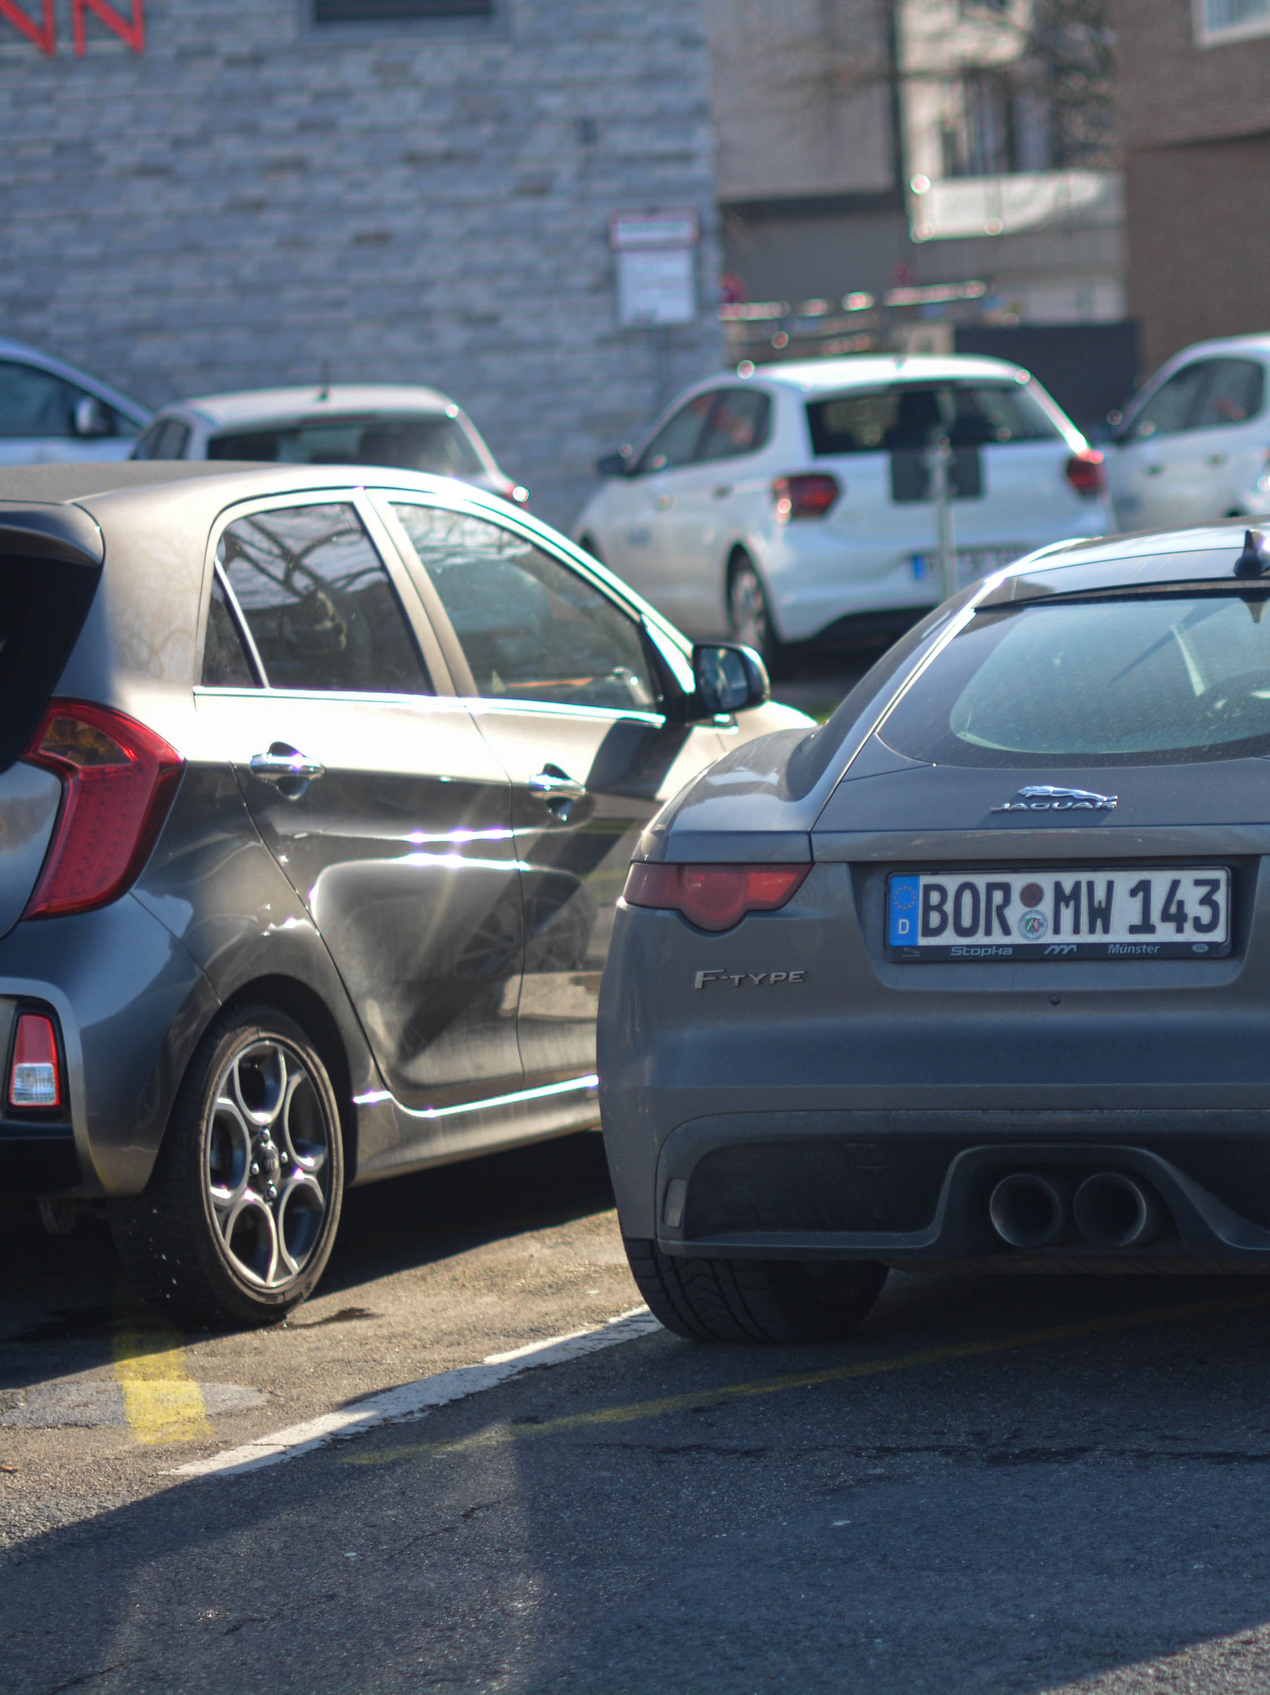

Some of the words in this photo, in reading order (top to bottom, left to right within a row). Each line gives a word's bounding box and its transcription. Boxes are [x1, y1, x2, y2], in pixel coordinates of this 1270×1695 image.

[990, 801, 1117, 812] JAGUAR
[921, 881, 1012, 938] BOR
[1053, 880, 1115, 935] MW
[1128, 878, 1221, 935] 143
[898, 919, 910, 935] D
[950, 945, 1013, 957] Stopka
[1107, 943, 1161, 955] Münster
[694, 969, 807, 990] F-TYPE
